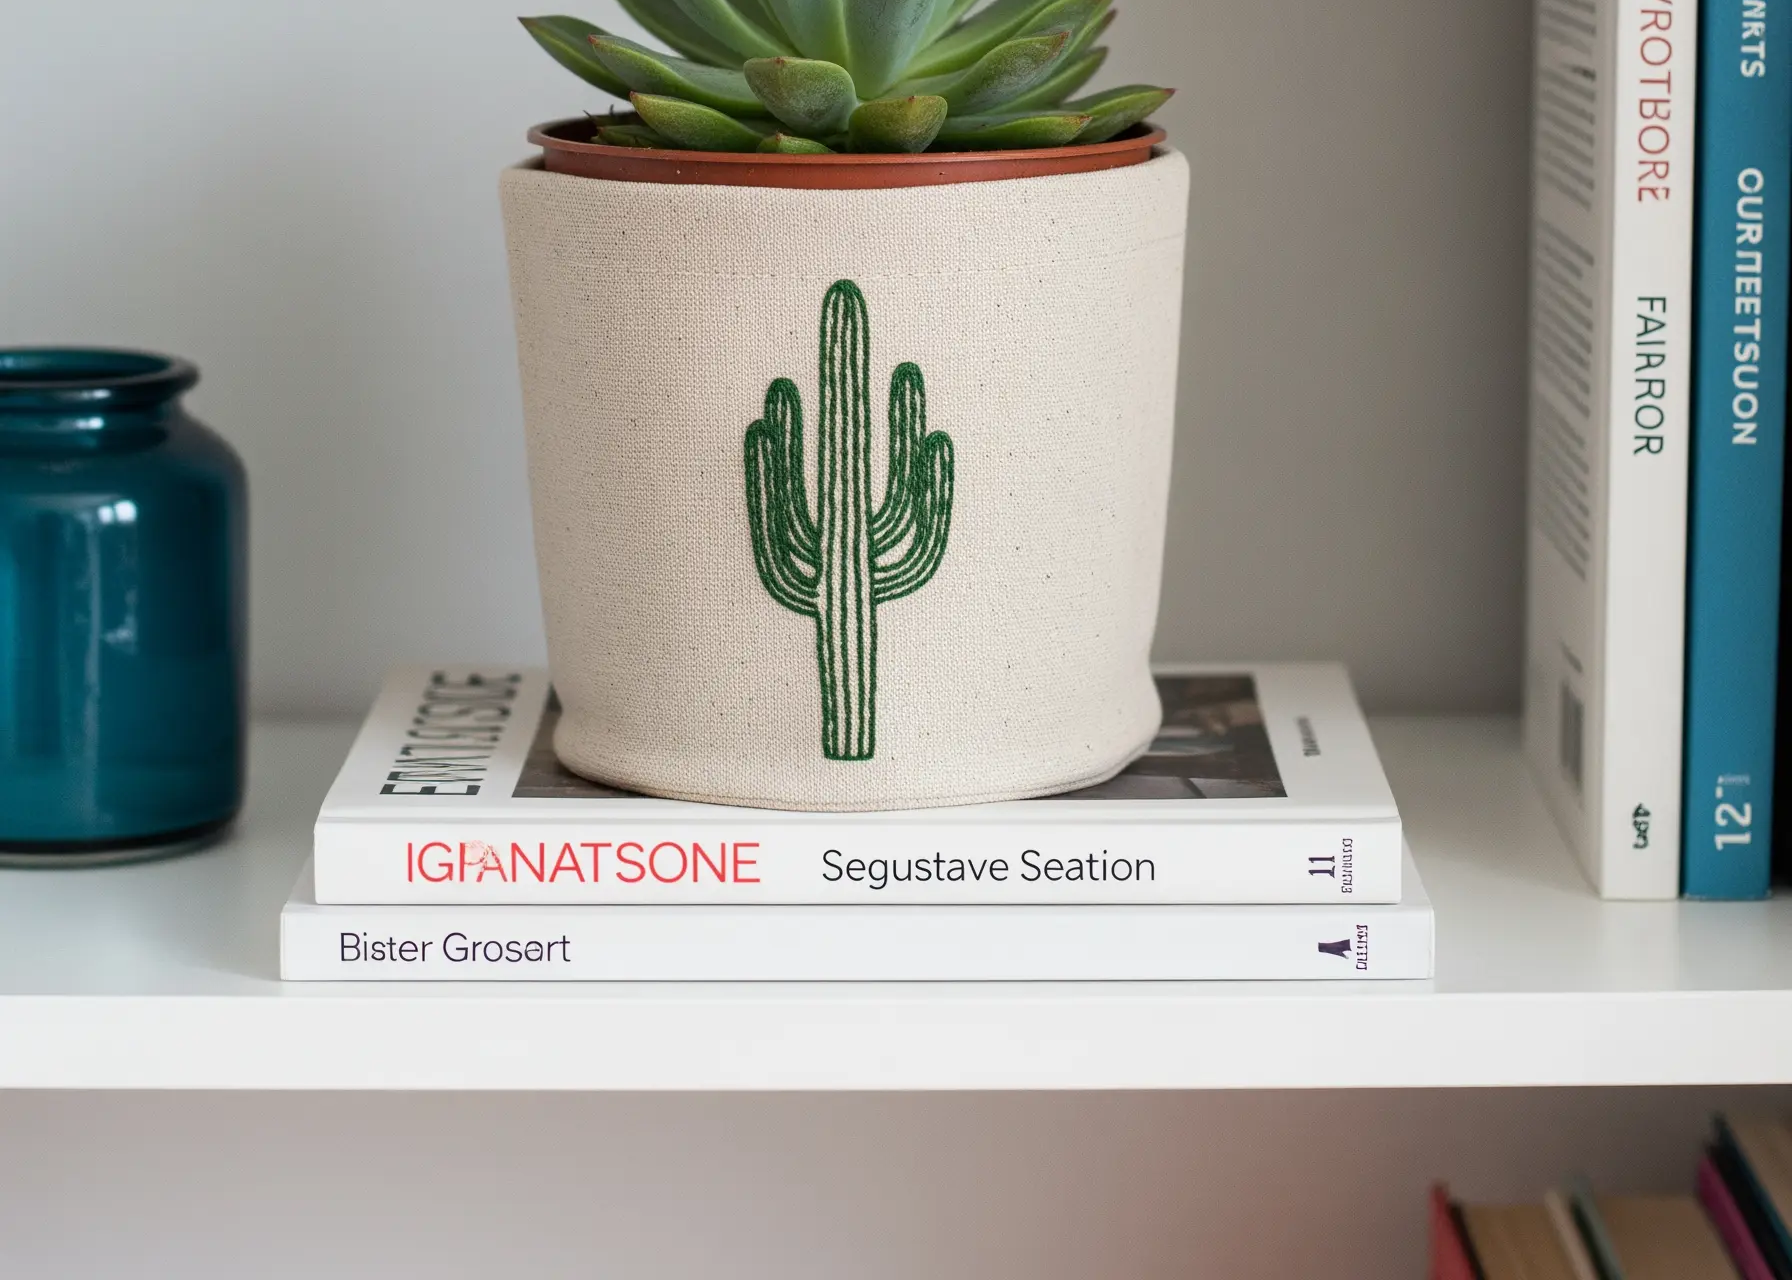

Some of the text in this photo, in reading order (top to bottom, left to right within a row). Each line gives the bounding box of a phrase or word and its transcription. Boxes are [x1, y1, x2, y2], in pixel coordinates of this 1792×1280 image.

[822, 849, 1009, 891] Segustave
[1020, 849, 1155, 882] Seation
[340, 931, 433, 963] Bister
